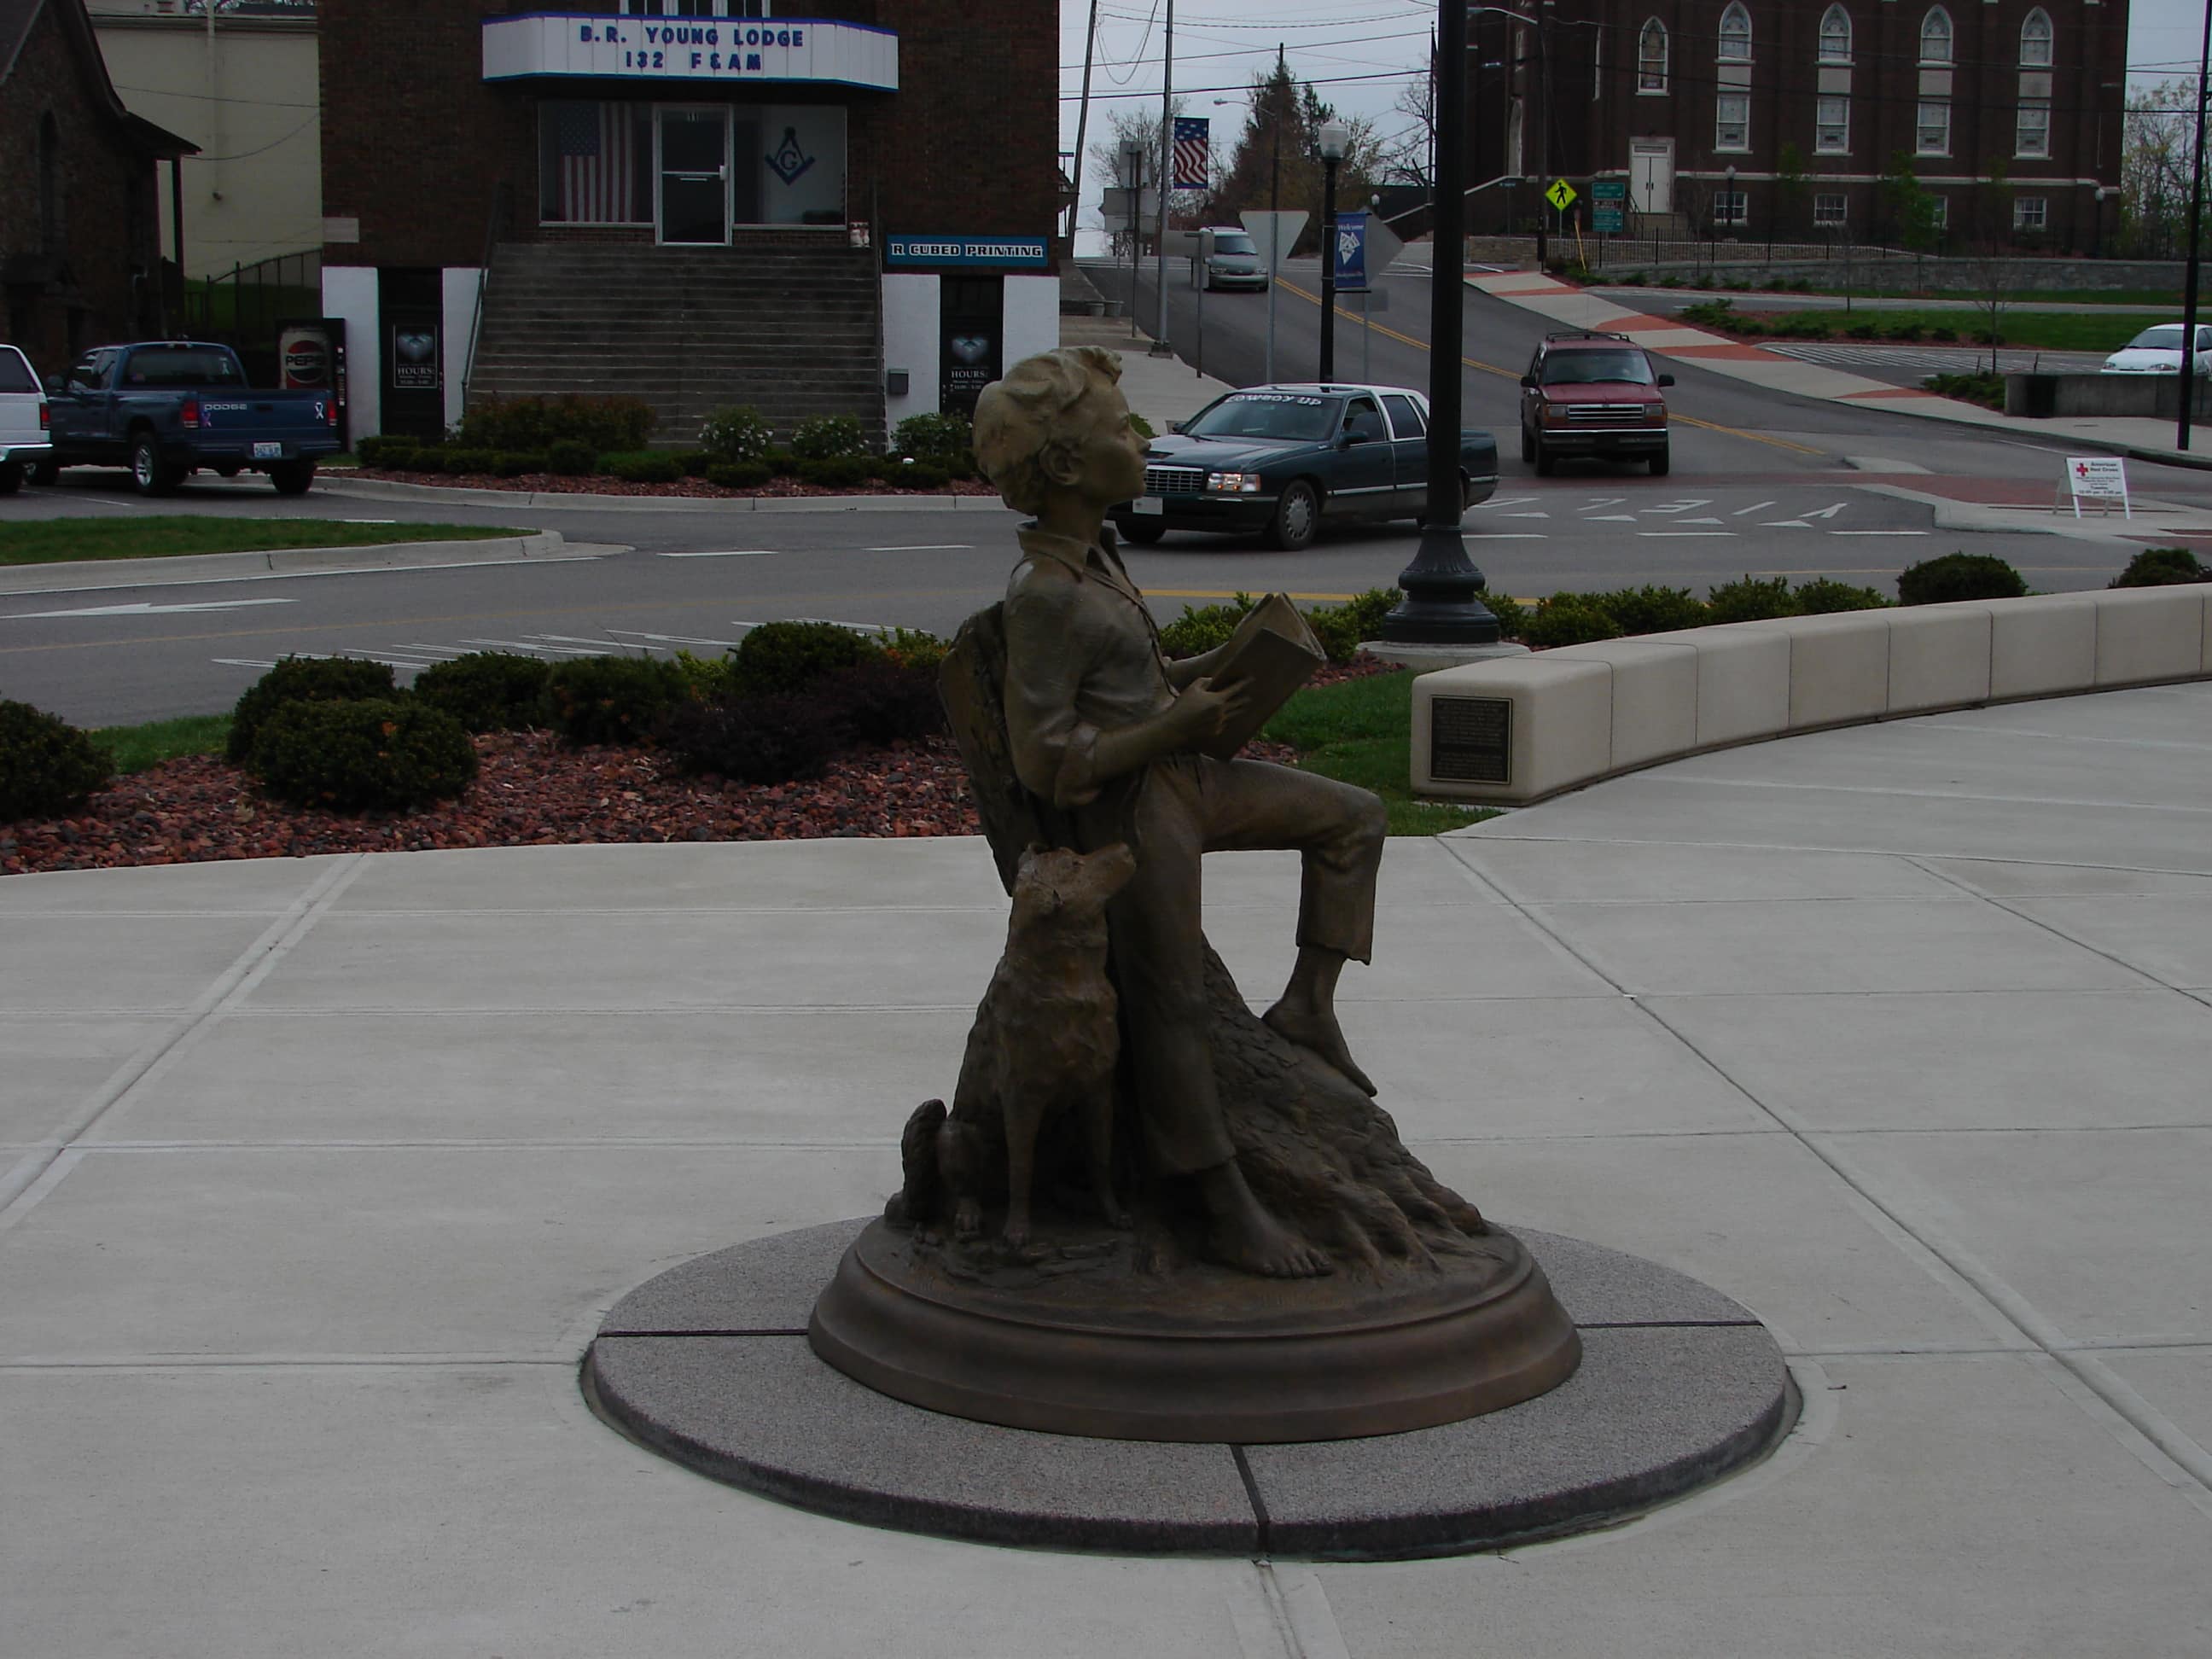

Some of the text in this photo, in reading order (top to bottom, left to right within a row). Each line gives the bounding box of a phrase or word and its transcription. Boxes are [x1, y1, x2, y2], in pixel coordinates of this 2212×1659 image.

[580, 25, 804, 47] B.R. YOUNG LODGE
[626, 51, 761, 70] 132 F&AM
[891, 243, 1044, 258] R CUBED PRINTING
